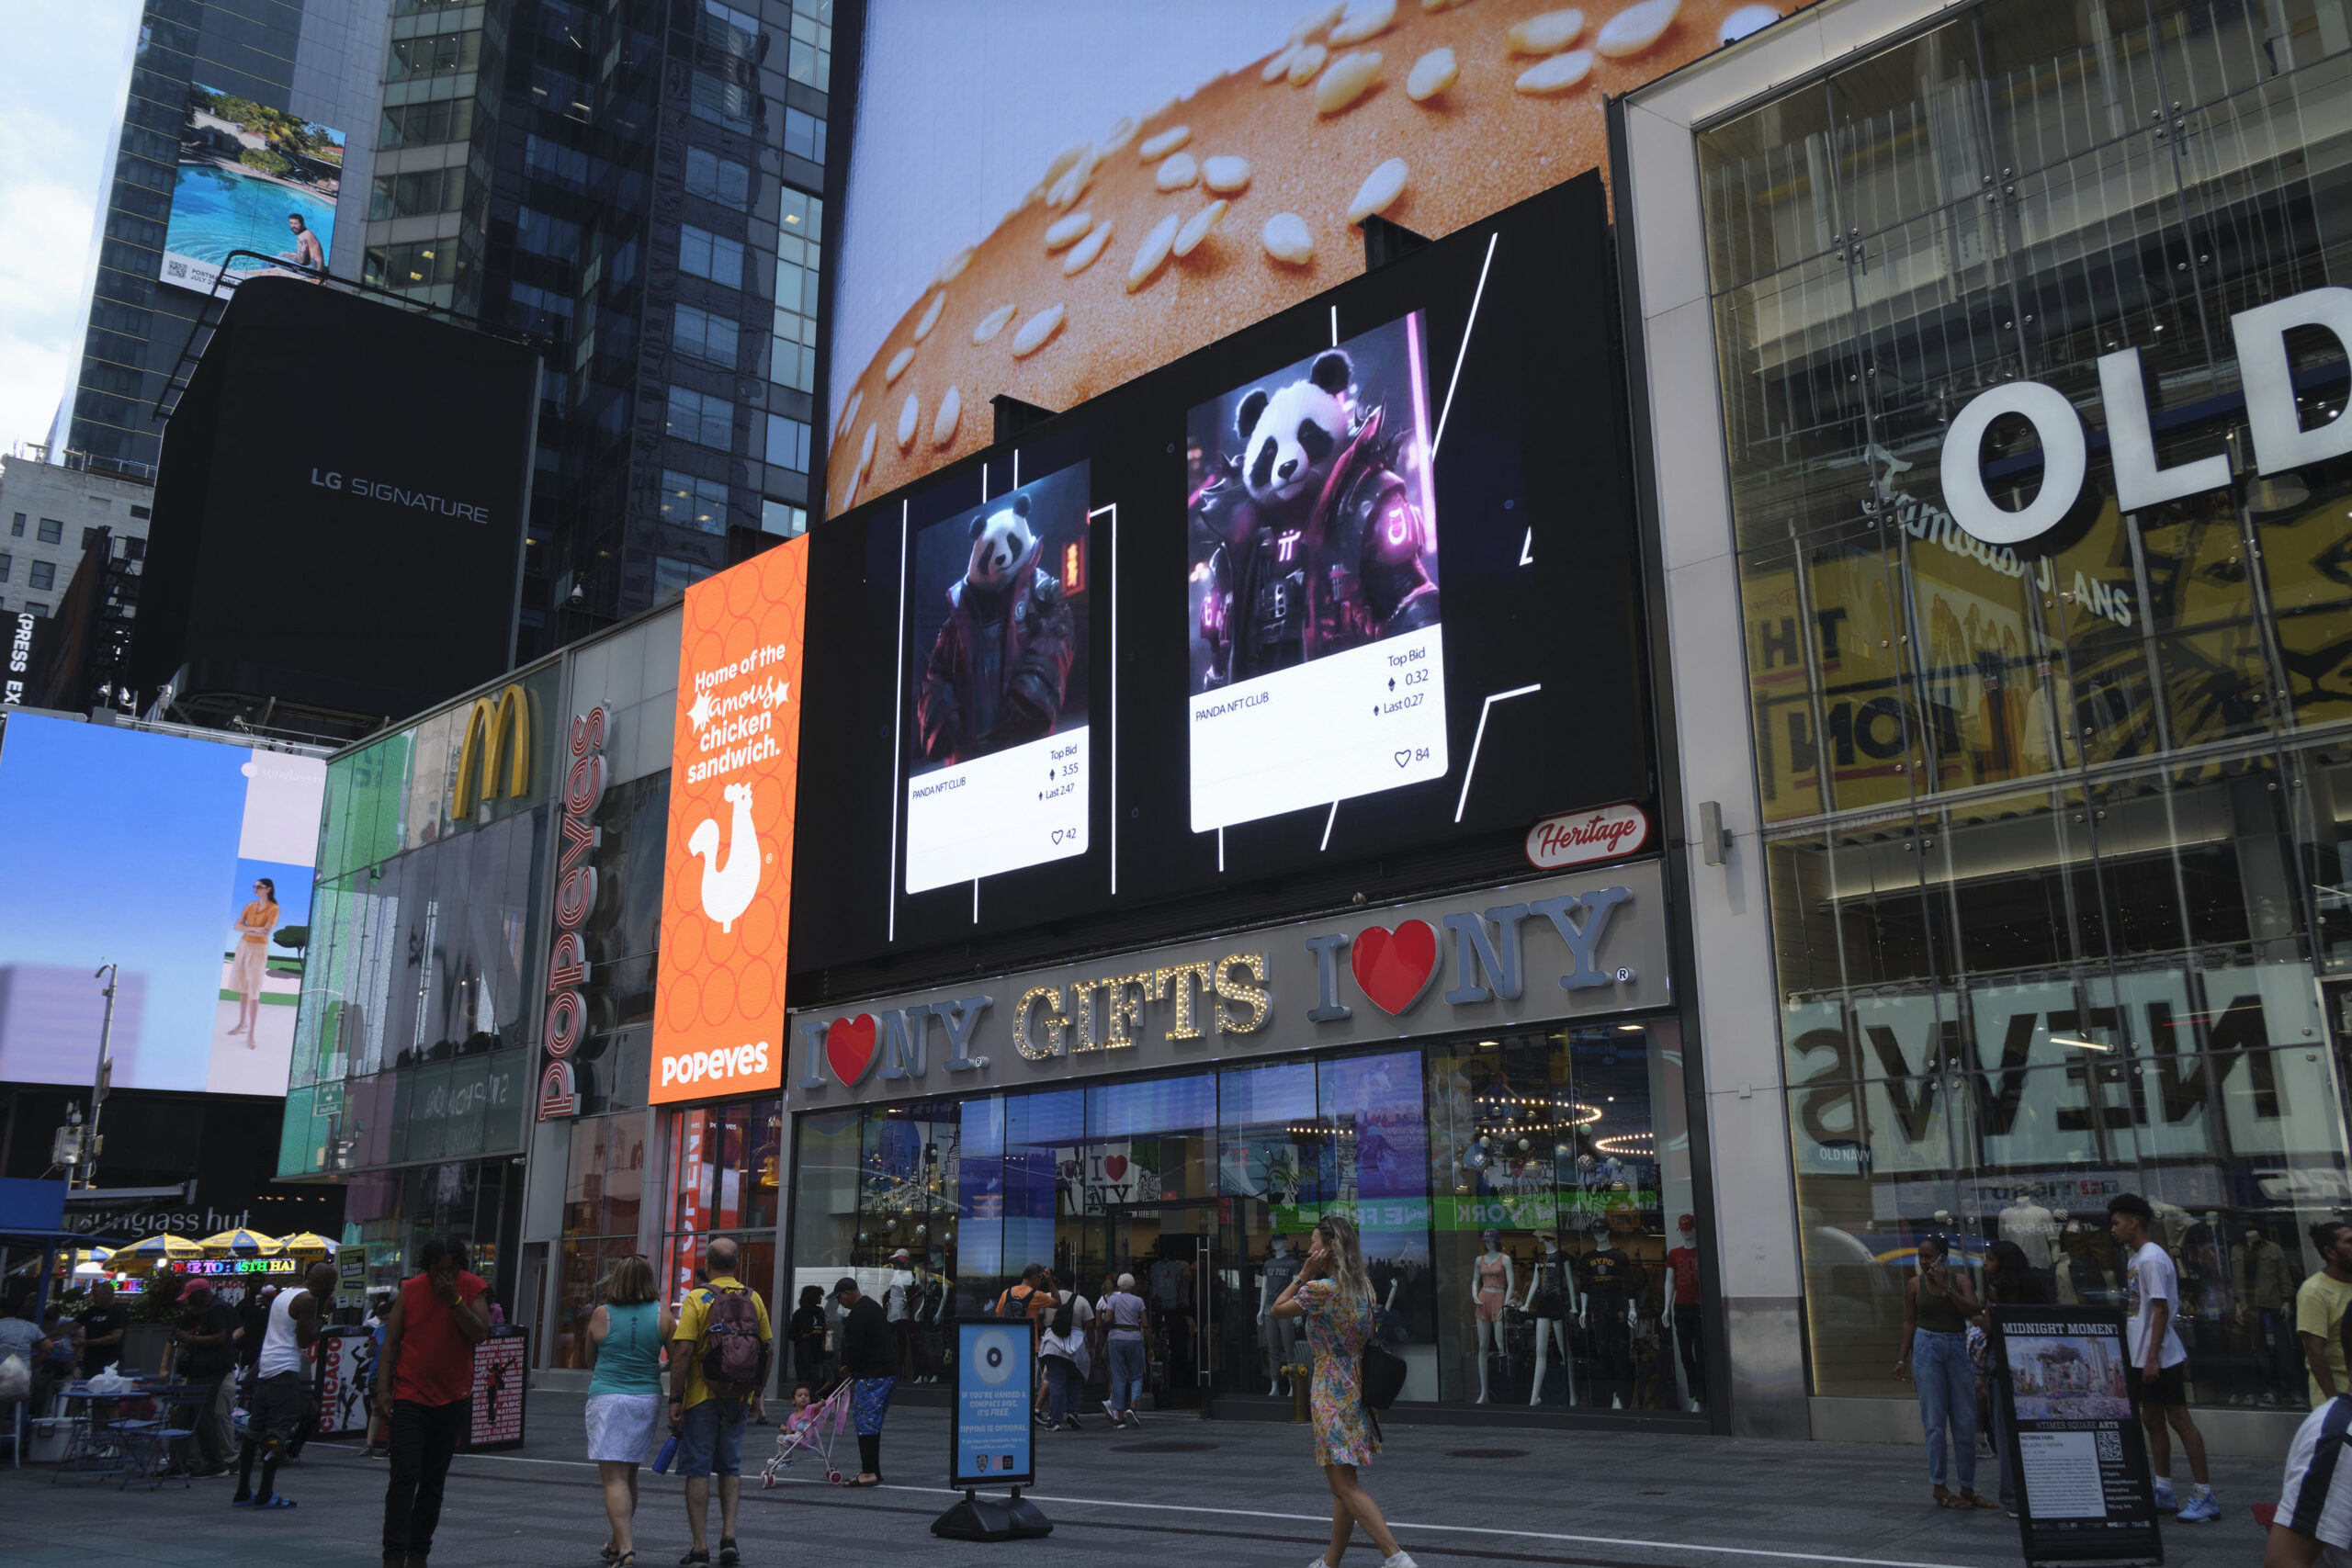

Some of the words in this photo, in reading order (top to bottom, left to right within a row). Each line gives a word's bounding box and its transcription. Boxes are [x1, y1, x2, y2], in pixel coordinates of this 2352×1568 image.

[1940, 285, 2352, 544] OLD
[311, 468, 342, 490] LG
[351, 478, 489, 524] SIGNATURE
[2036, 553, 2132, 628] JANS
[1386, 653, 1408, 668] Top
[1408, 647, 1426, 661] Bid
[695, 662, 738, 693] Home
[740, 649, 758, 675] of
[760, 643, 786, 668] the
[1405, 669, 1429, 686] 0.32
[1195, 704, 1227, 722] PANDA
[1227, 698, 1244, 713] NFT
[1245, 691, 1270, 708] CLUB
[1383, 700, 1404, 715] Last
[1404, 693, 1425, 709] 0.27
[699, 710, 772, 752] chicken
[687, 733, 781, 784] sandwich.
[1050, 750, 1065, 761] Top
[1065, 743, 1078, 757] Bid
[1415, 747, 1430, 762] 84
[1062, 761, 1079, 777] 3.55
[912, 786, 935, 800] PANDA
[935, 781, 949, 794] NFT
[948, 776, 967, 791] CLUB
[1046, 788, 1060, 800] Last
[1060, 782, 1075, 796] 2.47
[1065, 828, 1077, 840] 42
[1537, 814, 1637, 858] Heritage
[797, 1021, 828, 1089] I
[876, 994, 993, 1081] NY
[1012, 951, 1273, 1063] GIFTS
[1305, 931, 1352, 1023] I
[1442, 886, 1635, 1006] NY
[1819, 1145, 1841, 1163] OLD
[1842, 1146, 1872, 1164] NAVY
[206, 1206, 253, 1232] hut
[1589, 1257, 1616, 1268] NYPD
[2002, 1322, 2064, 1335] MIDNIGHT
[319, 1337, 342, 1432] CHICAGO
[961, 1392, 968, 1400] IF
[969, 1391, 993, 1399] YOU'RE
[993, 1390, 1021, 1399] HANDED
[1021, 1390, 1027, 1398] A
[969, 1399, 1001, 1408] COMPACT
[977, 1408, 989, 1417] IT'S
[960, 1425, 986, 1434] TIPPING
[987, 1425, 994, 1433] IS
[2041, 1421, 2066, 1429] TIMES
[2066, 1421, 2098, 1429] SQUARE
[2098, 1420, 2120, 1429] ARTS
